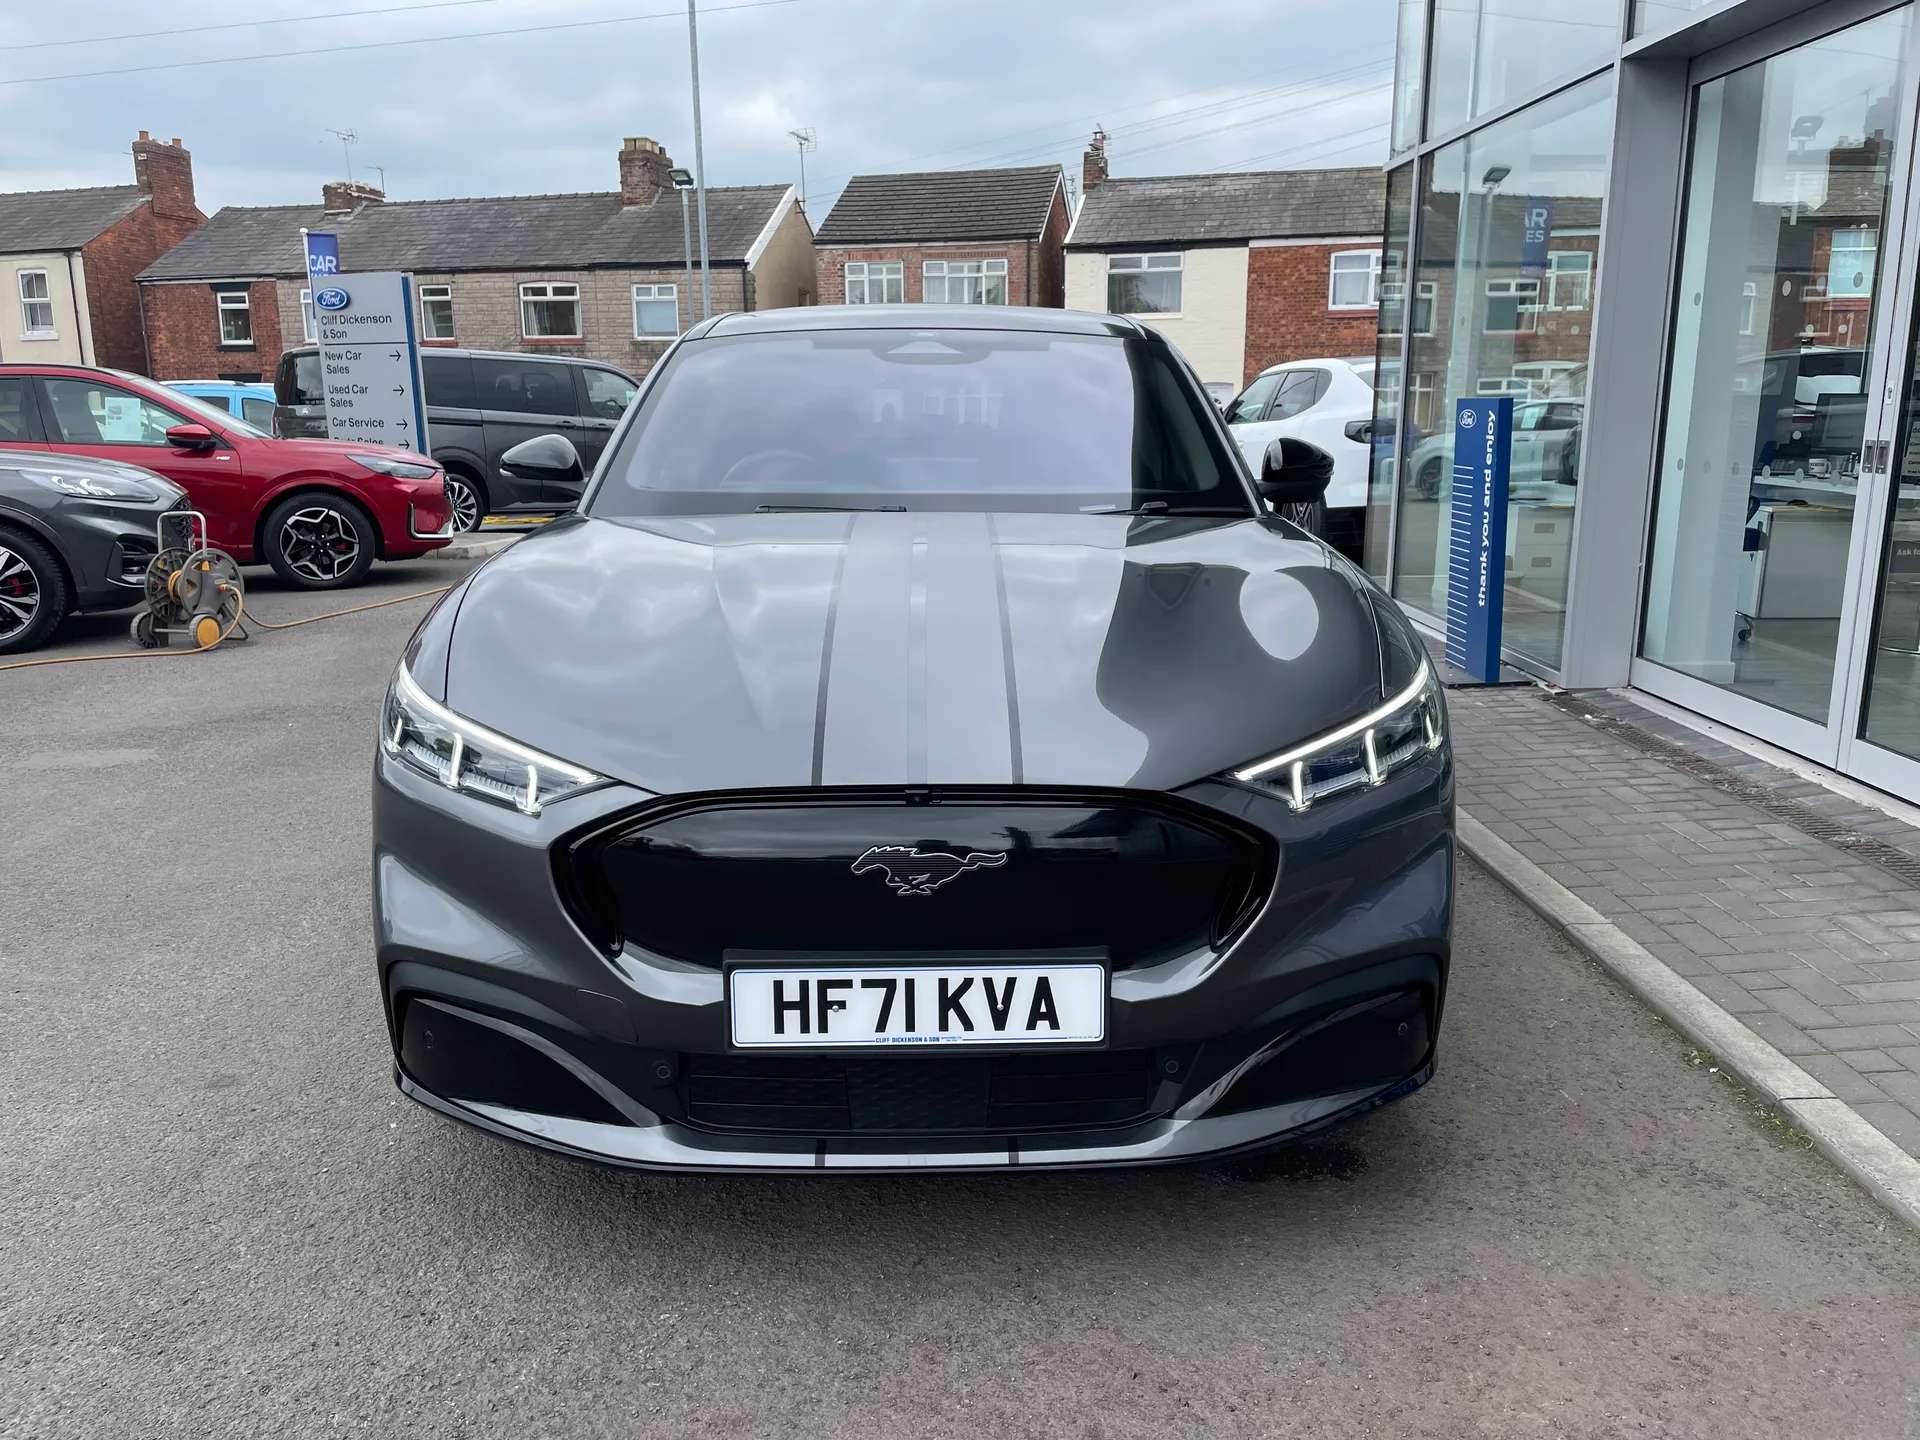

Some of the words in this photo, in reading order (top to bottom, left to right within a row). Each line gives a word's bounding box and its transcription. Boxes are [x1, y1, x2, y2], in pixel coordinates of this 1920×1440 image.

[310, 255, 336, 272] CAR
[321, 315, 338, 325] Cliff
[340, 315, 392, 325] Dickenson
[323, 329, 329, 339] &
[330, 329, 348, 339] Son
[325, 351, 343, 361] New
[345, 350, 362, 360] Car
[327, 363, 350, 374] Sales
[328, 384, 350, 394] Used
[352, 384, 369, 393] Car
[330, 397, 354, 408] Sales
[332, 417, 347, 427] Car
[348, 417, 385, 428] Service
[1485, 410, 1496, 464] enjoy
[1483, 469, 1492, 506] and
[1482, 511, 1490, 547] you
[1478, 550, 1488, 608] thank
[773, 979, 916, 1034] HF71
[938, 976, 1061, 1032] KVA
